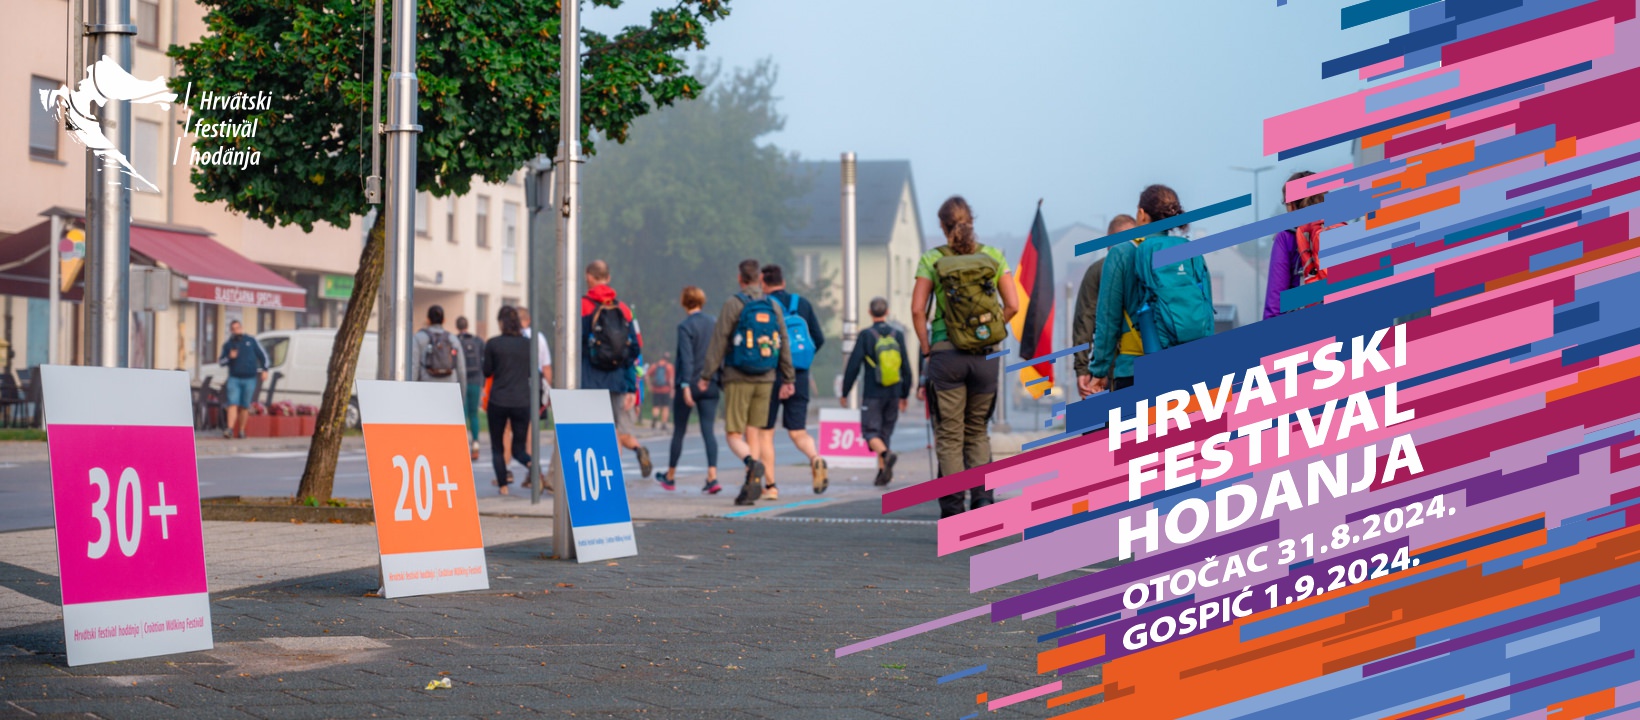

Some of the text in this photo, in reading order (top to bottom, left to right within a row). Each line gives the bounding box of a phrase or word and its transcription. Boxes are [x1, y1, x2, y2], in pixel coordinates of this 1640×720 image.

[391, 454, 459, 521] 20+
[573, 447, 614, 501] 10+
[87, 467, 178, 559] 30+
